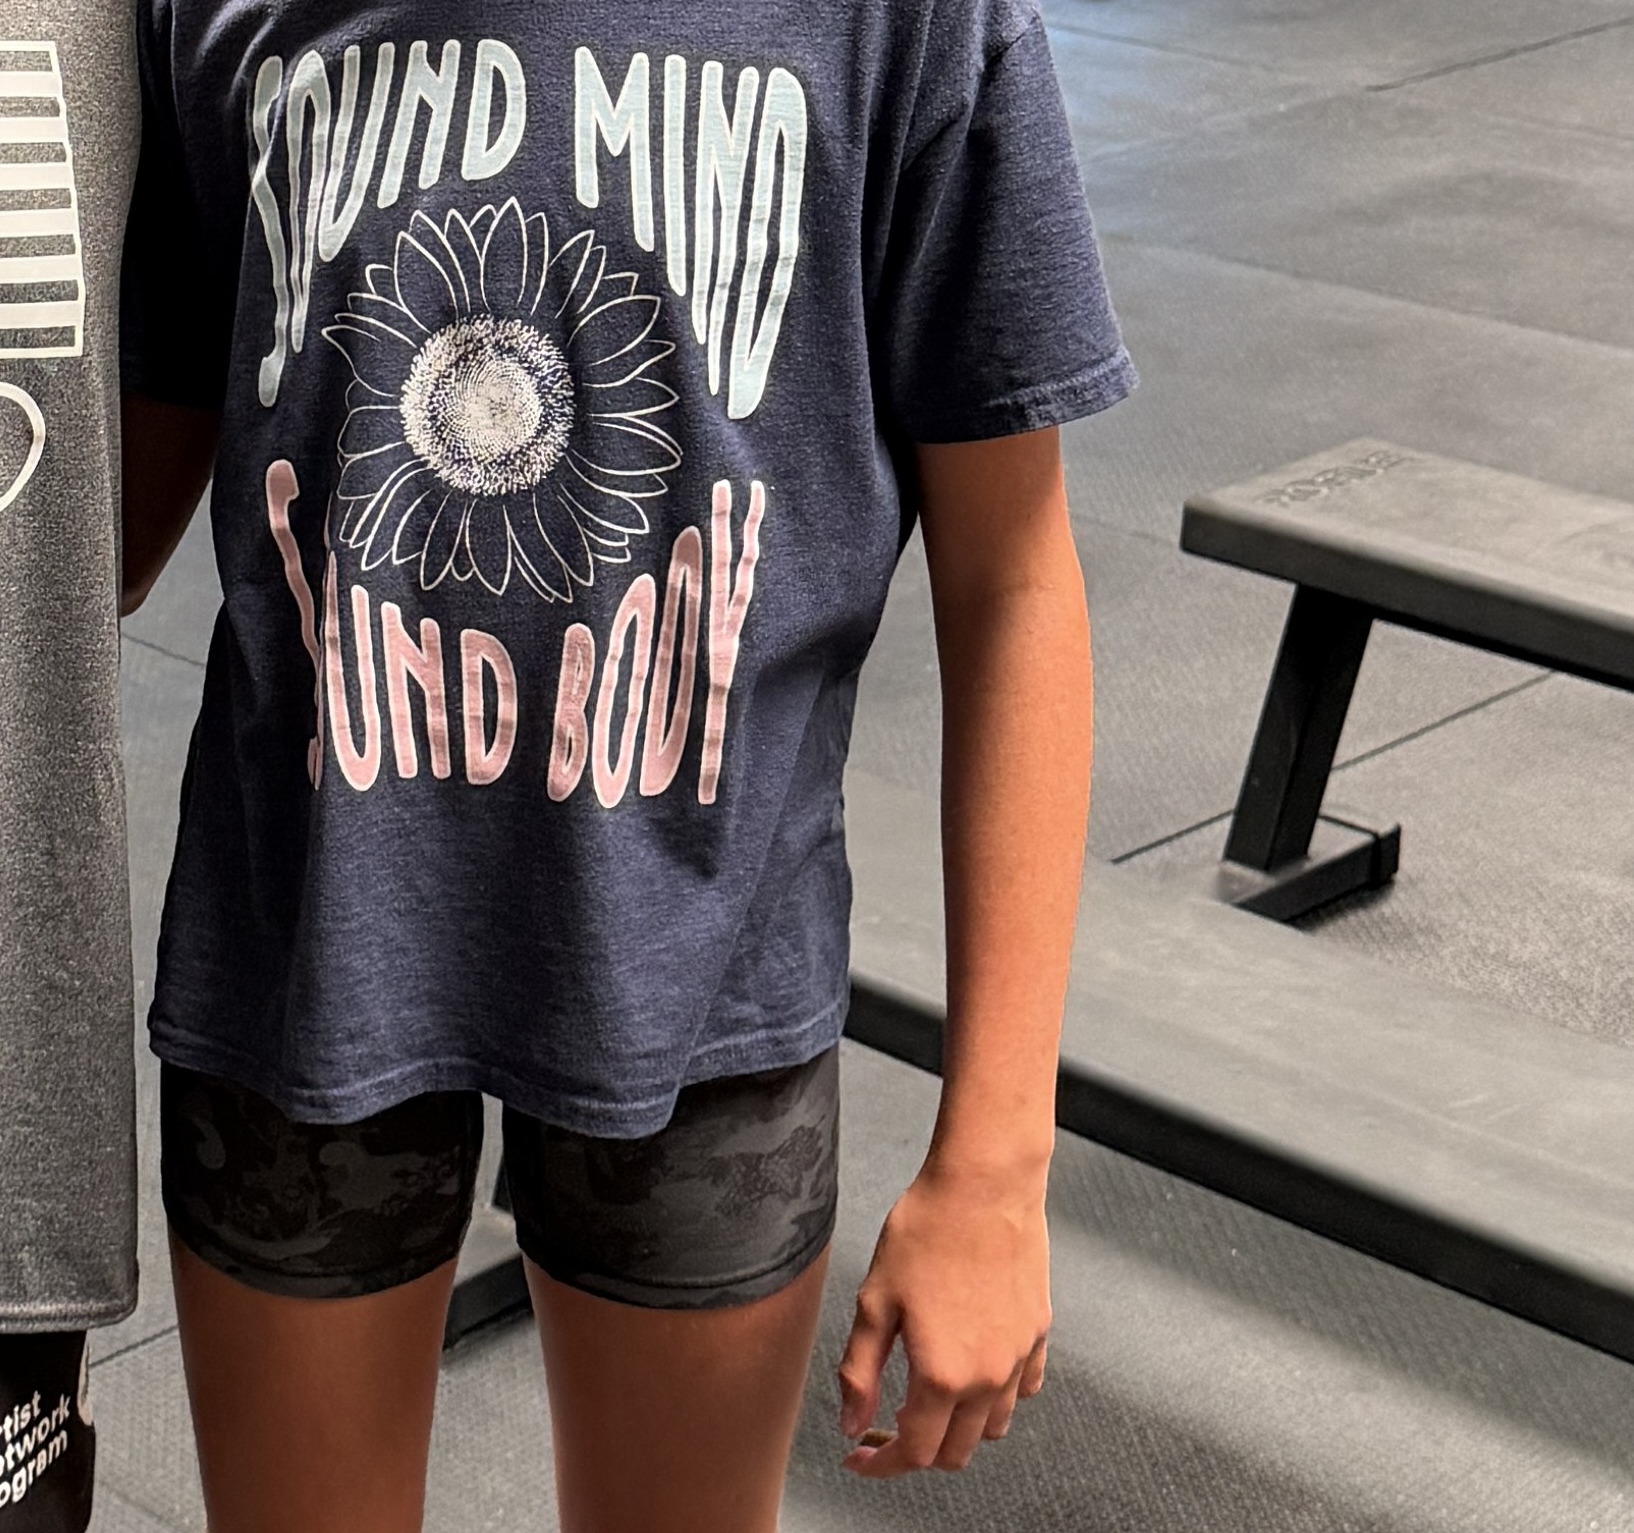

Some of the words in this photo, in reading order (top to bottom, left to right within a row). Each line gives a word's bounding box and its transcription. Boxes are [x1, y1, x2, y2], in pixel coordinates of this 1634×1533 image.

[252, 39, 528, 408] SOUND
[574, 45, 807, 421] MIND
[546, 478, 765, 808] BODY
